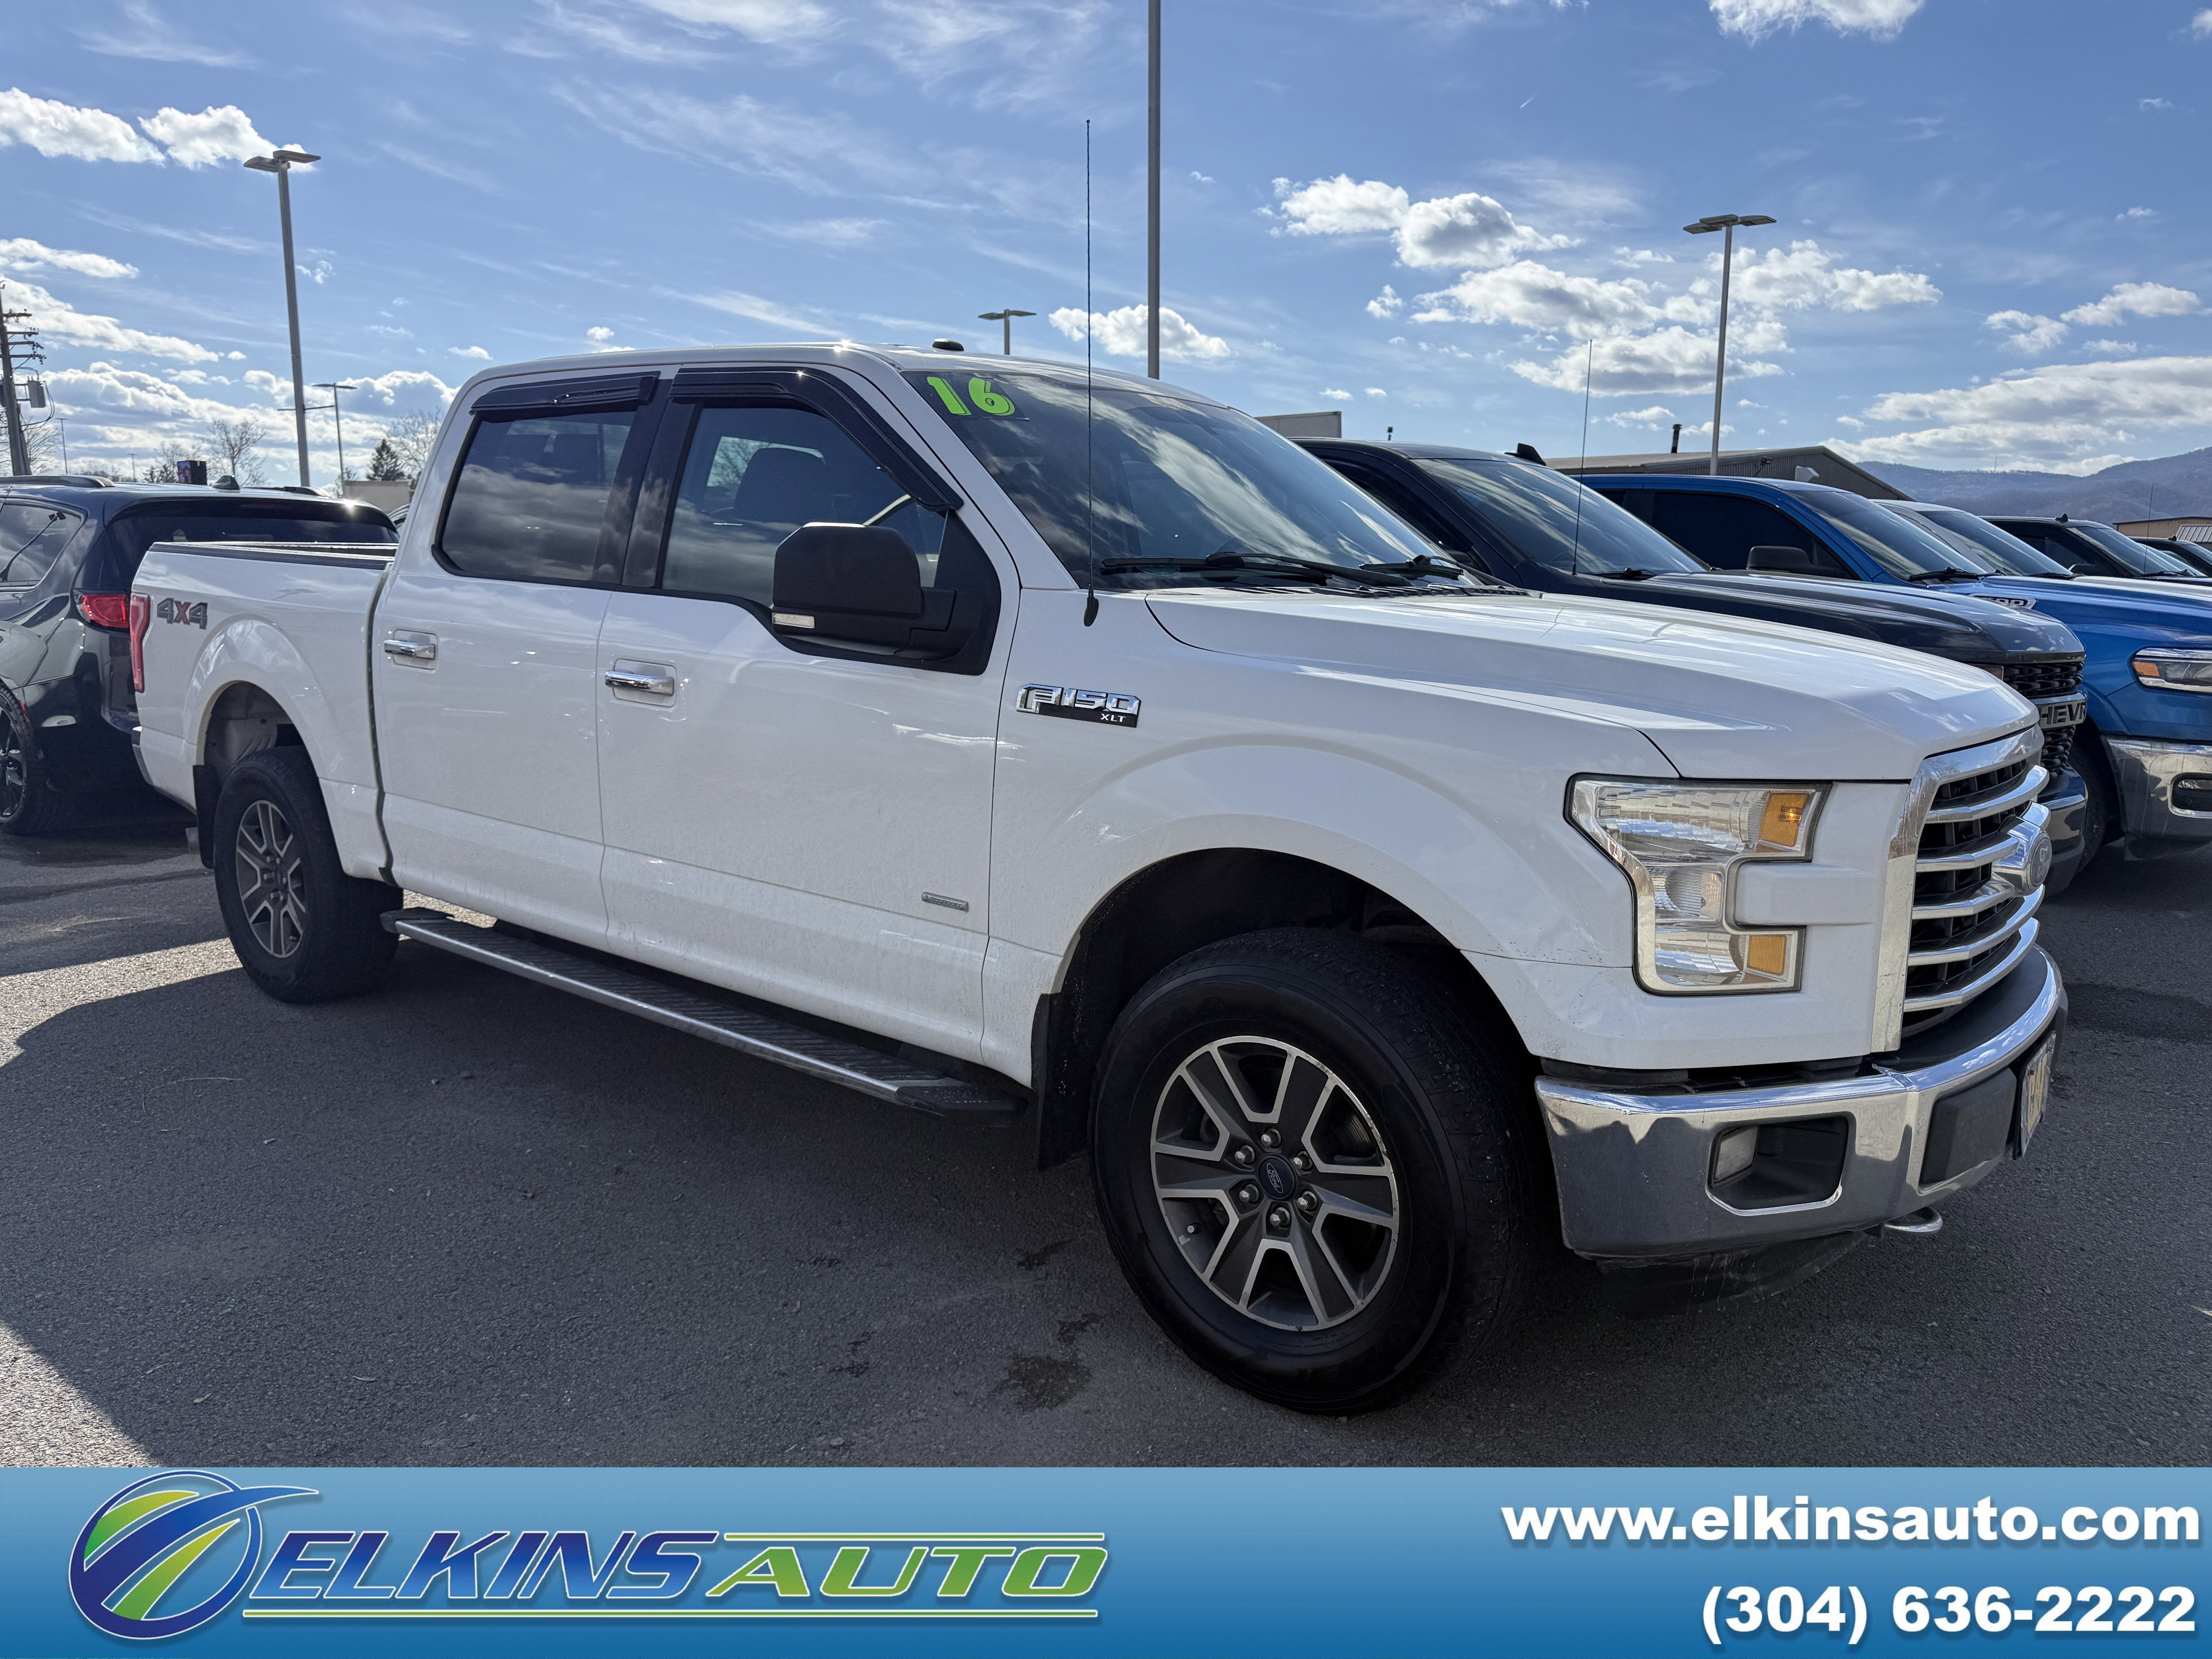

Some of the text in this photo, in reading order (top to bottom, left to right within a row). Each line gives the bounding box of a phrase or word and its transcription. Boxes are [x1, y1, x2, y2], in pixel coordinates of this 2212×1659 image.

[927, 376, 1015, 416] 16
[1100, 713, 1127, 723] XLT
[1268, 1169, 1281, 1188] Ford
